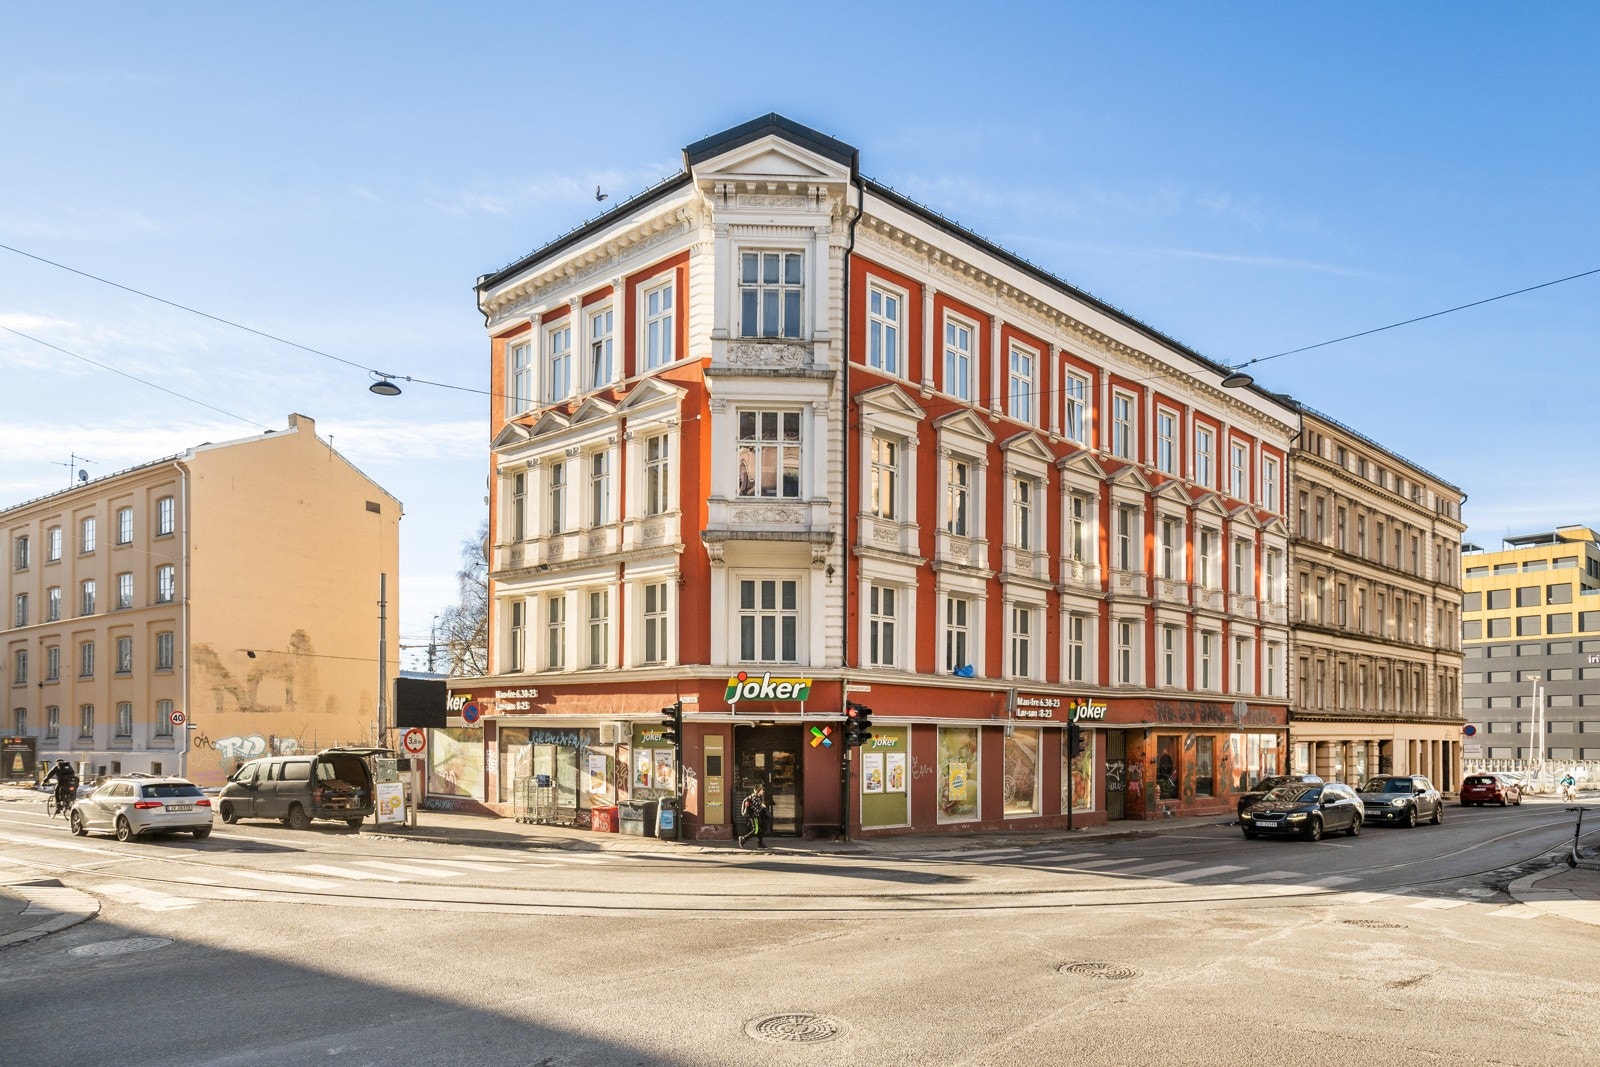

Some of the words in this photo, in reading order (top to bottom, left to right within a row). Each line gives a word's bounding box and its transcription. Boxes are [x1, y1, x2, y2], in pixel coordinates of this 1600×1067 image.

[727, 671, 806, 704] joker
[446, 689, 466, 711] ker
[1040, 698, 1060, 708] 6.30-23
[173, 714, 183, 722] 40
[1073, 698, 1107, 722] joker
[872, 734, 897, 748] joker
